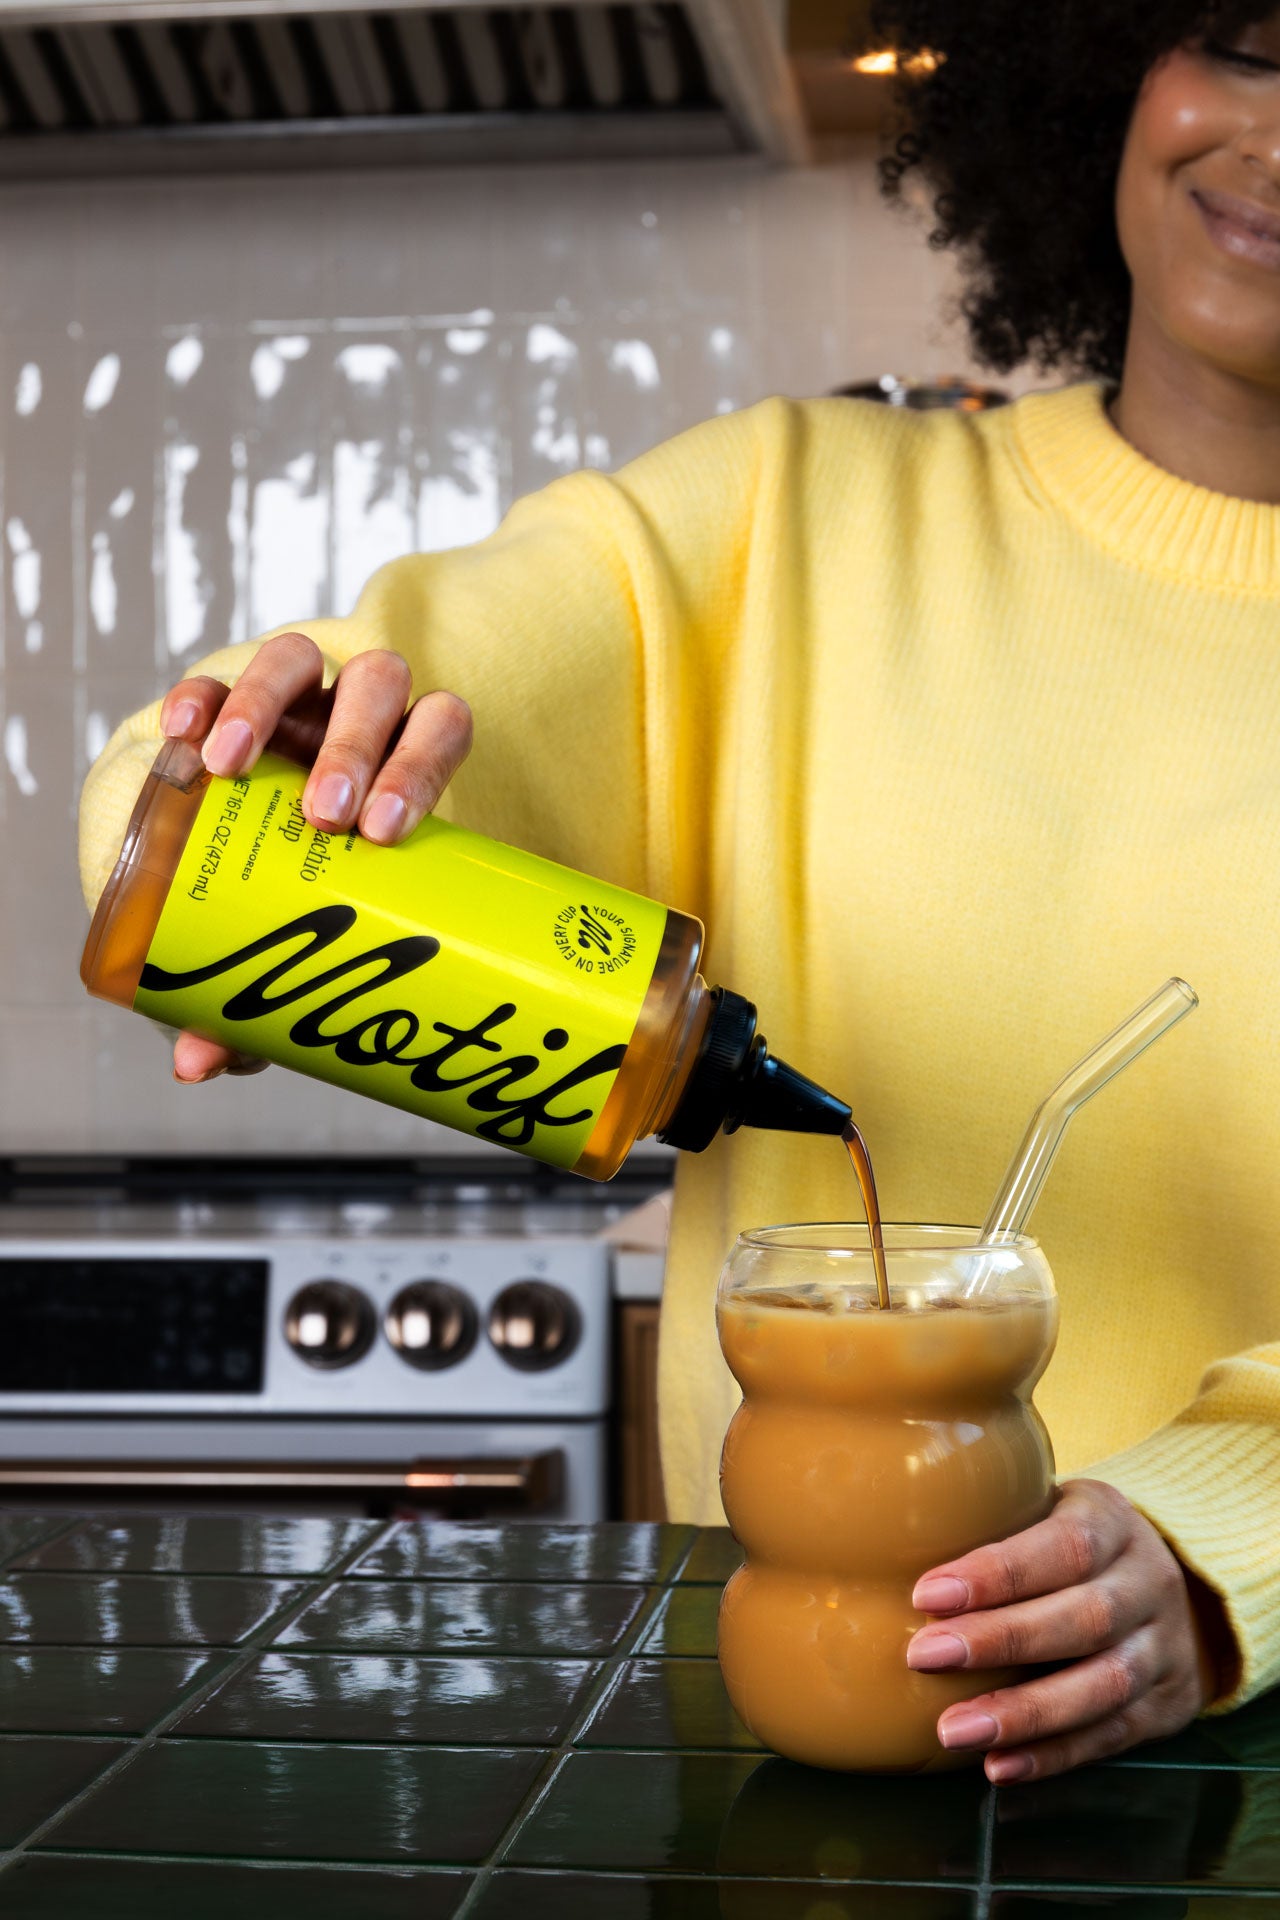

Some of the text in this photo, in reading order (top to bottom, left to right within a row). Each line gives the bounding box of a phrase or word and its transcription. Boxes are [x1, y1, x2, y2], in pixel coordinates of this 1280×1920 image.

[187, 777, 252, 902] NET 16 FL OZ (473 mL)
[241, 789, 283, 881] NATURALLY FLAVORED
[553, 905, 637, 974] YOUR SIGNATURE ON EVERY CUP
[138, 904, 630, 1147] Motif
